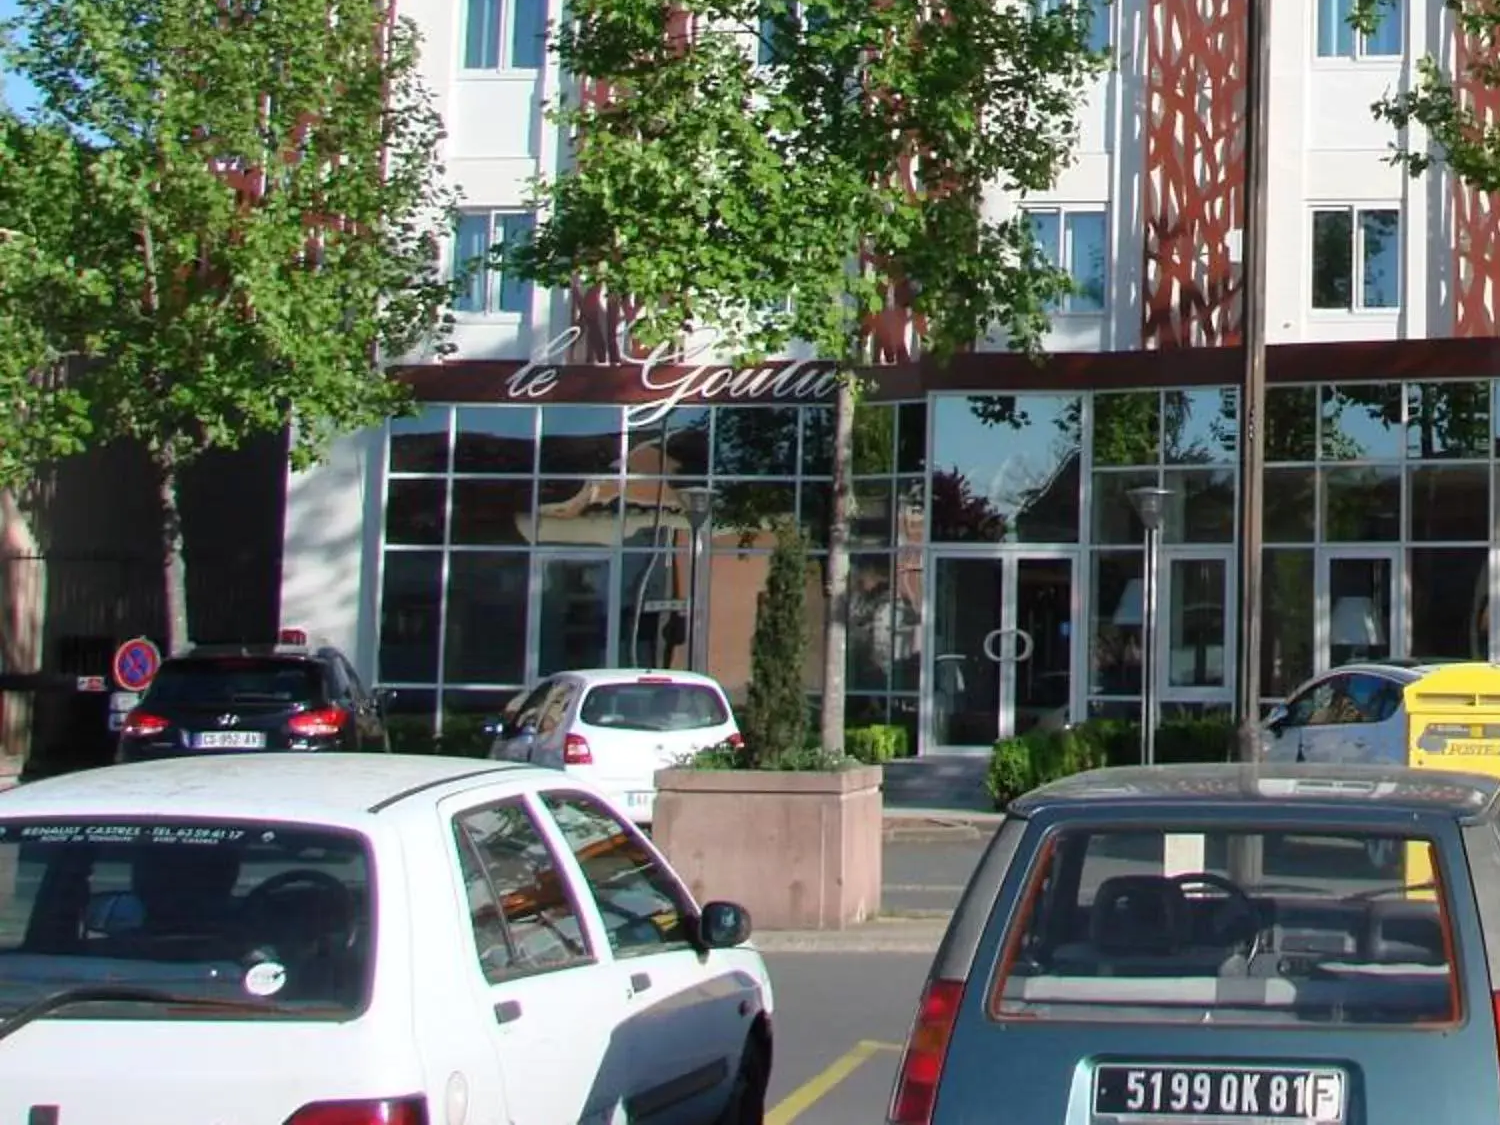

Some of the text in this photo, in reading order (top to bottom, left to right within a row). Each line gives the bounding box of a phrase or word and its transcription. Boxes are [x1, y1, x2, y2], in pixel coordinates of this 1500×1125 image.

[506, 326, 581, 398] le
[1449, 743, 1496, 756] POSTE
[1126, 1071, 1212, 1111] 5199
[1268, 1076, 1306, 1114] 81
